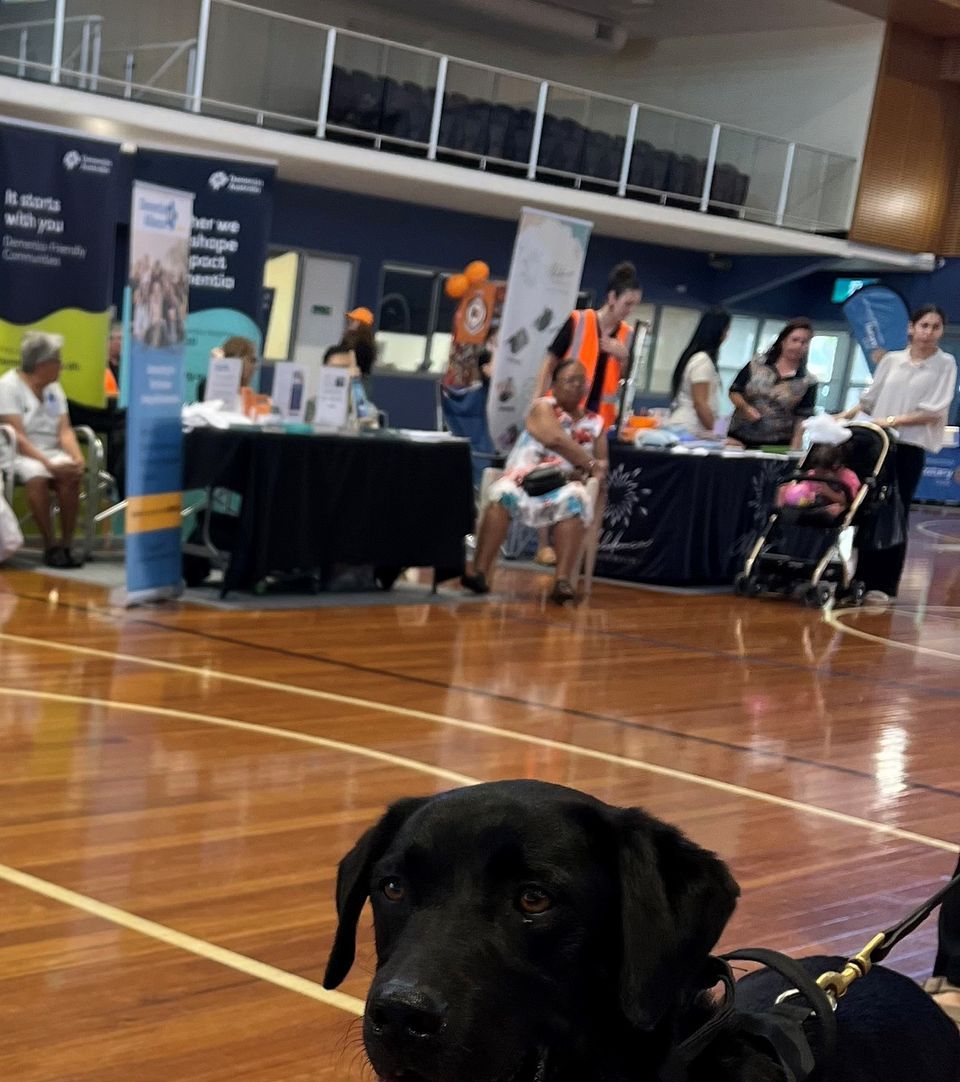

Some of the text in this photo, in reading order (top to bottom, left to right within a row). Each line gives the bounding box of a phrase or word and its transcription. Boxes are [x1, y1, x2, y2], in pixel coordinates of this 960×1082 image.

[5, 189, 61, 212] It starts
[5, 209, 64, 234] with you
[216, 220, 240, 234] we
[2, 250, 61, 266] Communities
